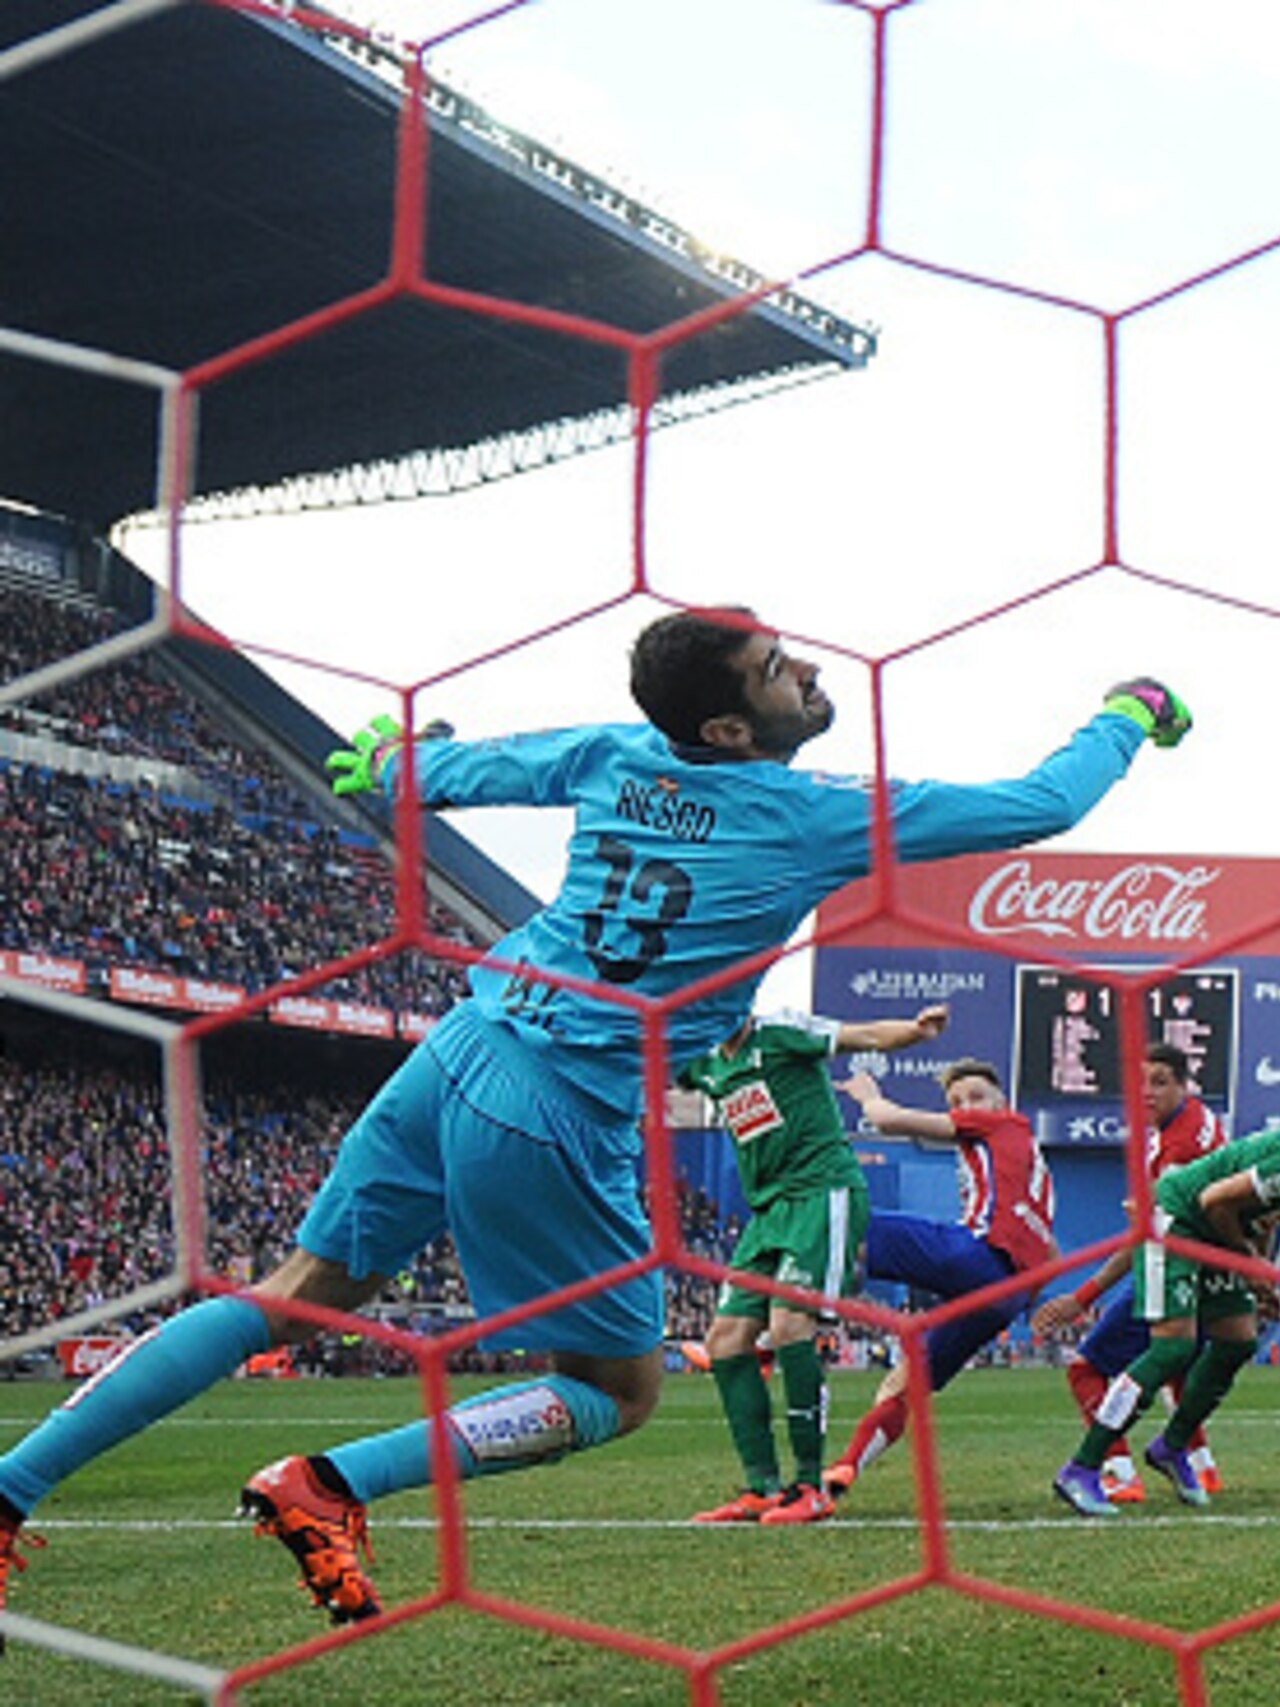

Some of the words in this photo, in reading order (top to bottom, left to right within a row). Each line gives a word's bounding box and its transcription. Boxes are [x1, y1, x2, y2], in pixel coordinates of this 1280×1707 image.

[582, 836, 693, 983] 13
[969, 861, 1221, 939] Coca-Cola
[1099, 987, 1110, 1016] 1
[1151, 988, 1161, 1016] 1
